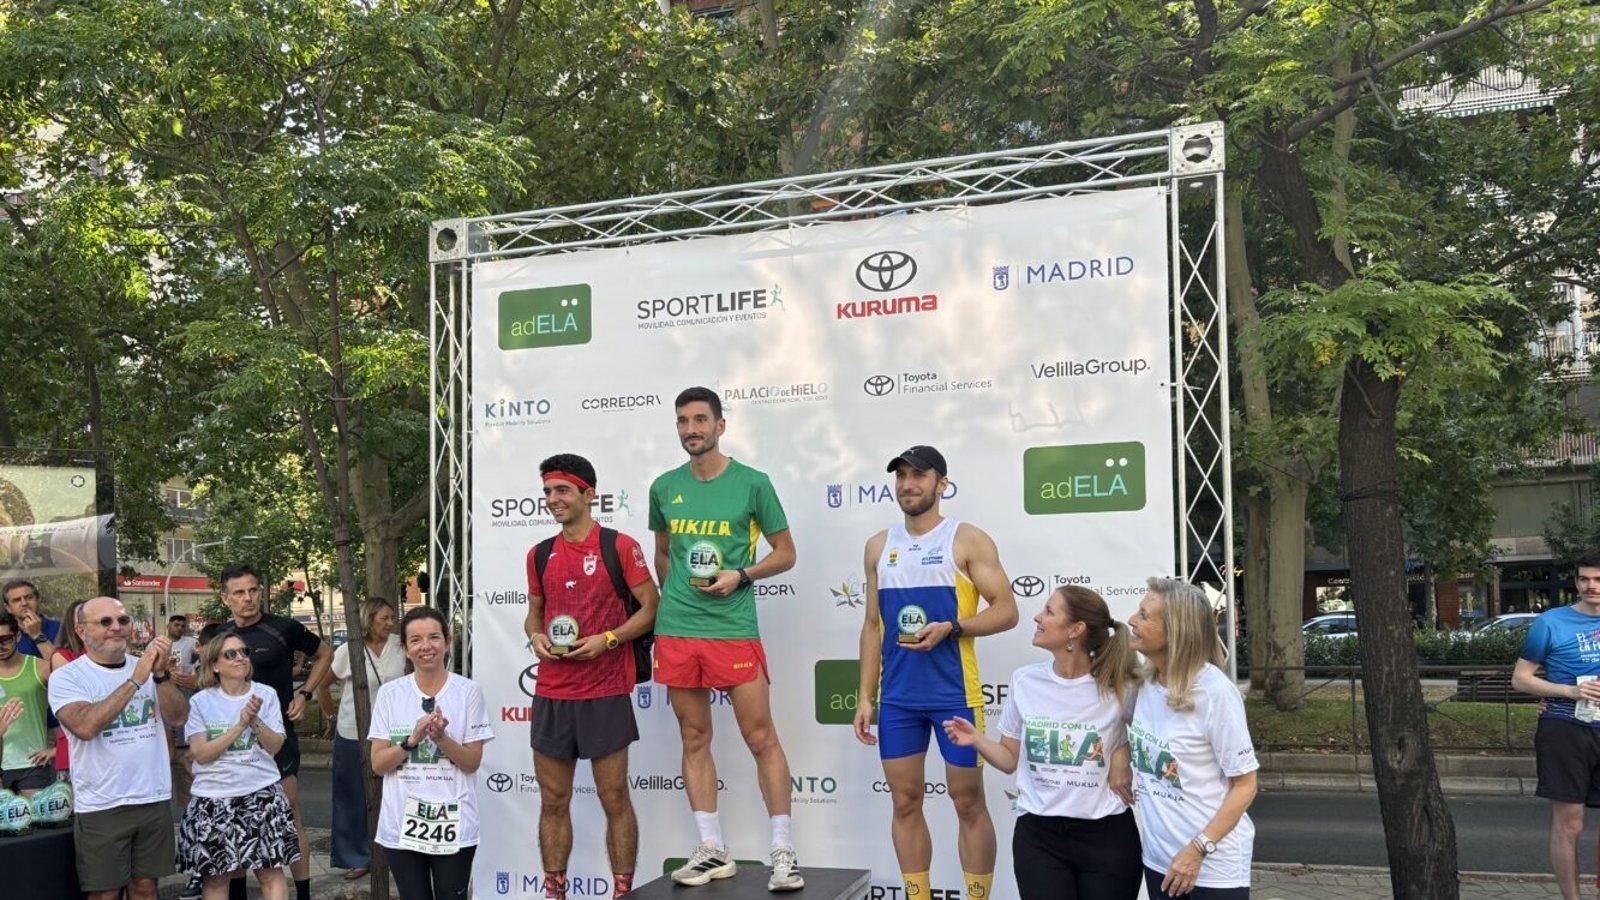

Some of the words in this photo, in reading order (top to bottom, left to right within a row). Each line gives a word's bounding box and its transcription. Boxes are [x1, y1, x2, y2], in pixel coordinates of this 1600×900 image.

[1027, 256, 1134, 284] MADRID
[637, 289, 767, 319] SPORTLIFE
[735, 312, 767, 320] EVENTOS
[903, 372, 937, 383] Toyota
[903, 382, 948, 394] Financial
[951, 380, 992, 390] Services
[858, 482, 958, 503] MAD
[690, 552, 719, 565] ELA
[132, 579, 161, 587] Santander
[1054, 575, 1091, 585] Toyota
[485, 591, 527, 605] Velilla
[901, 614, 924, 626] ELA
[552, 625, 576, 636] ELA
[1061, 722, 1081, 730] CON
[1025, 727, 1105, 768] ELA
[790, 776, 837, 794] NTO
[1067, 780, 1099, 788] MUKUA
[48, 799, 70, 812] ELA
[418, 802, 449, 820] ELA
[8, 806, 31, 819] ELA
[404, 819, 457, 843] 2246
